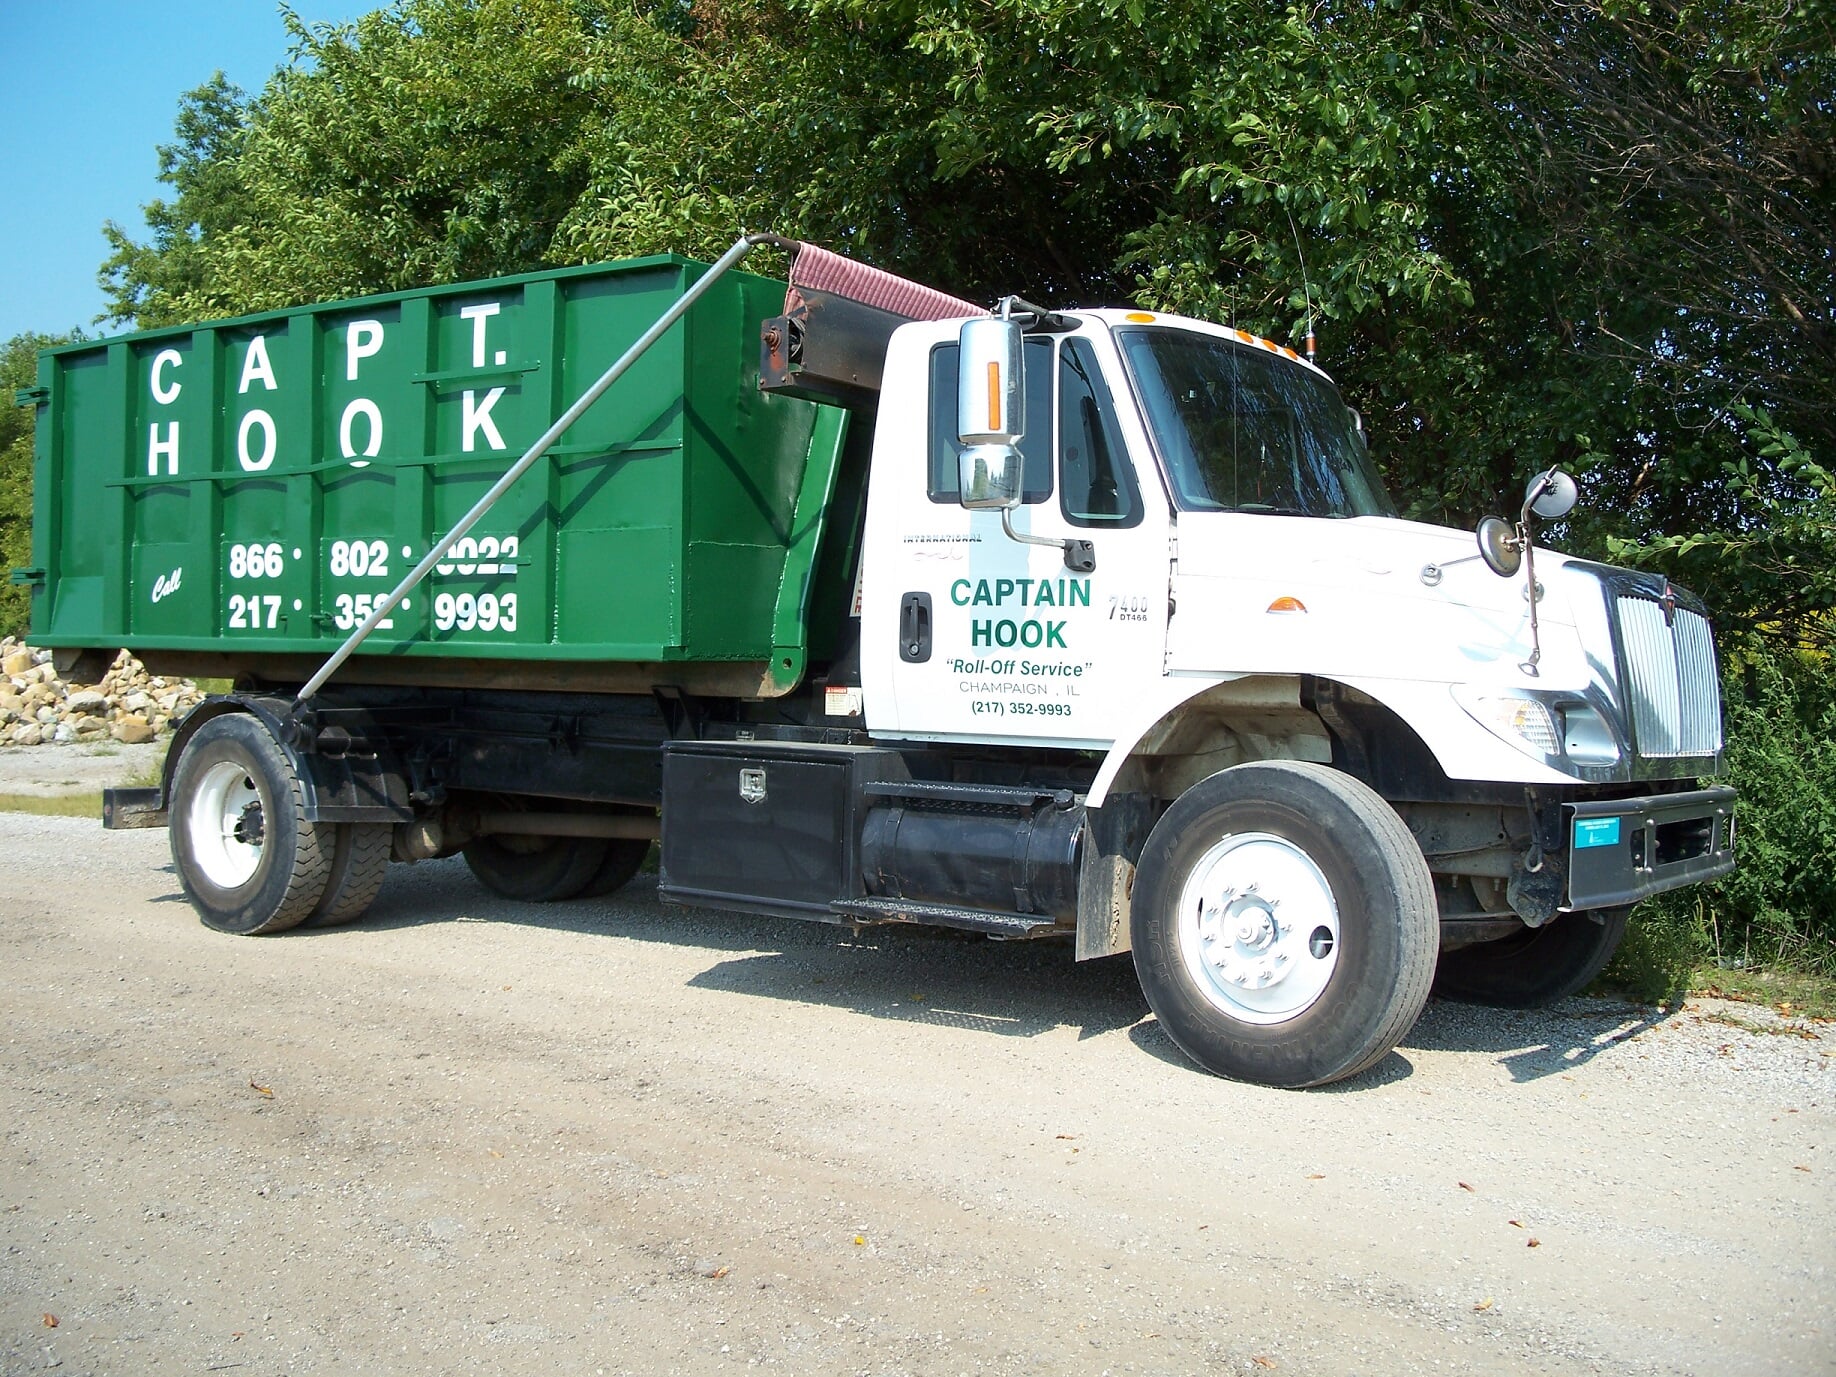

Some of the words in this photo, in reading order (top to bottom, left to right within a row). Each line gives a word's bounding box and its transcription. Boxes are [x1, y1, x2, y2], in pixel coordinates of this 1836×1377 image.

[148, 387, 507, 476] HOOK
[151, 567, 182, 603] Call
[950, 578, 1091, 607] CAPTAIN
[434, 592, 517, 632] 9993
[1120, 613, 1148, 622] DT466
[971, 619, 1068, 649] HOOK
[1066, 684, 1081, 697] IL
[971, 701, 1005, 717] (217)
[1009, 702, 1072, 717] 352-9993
